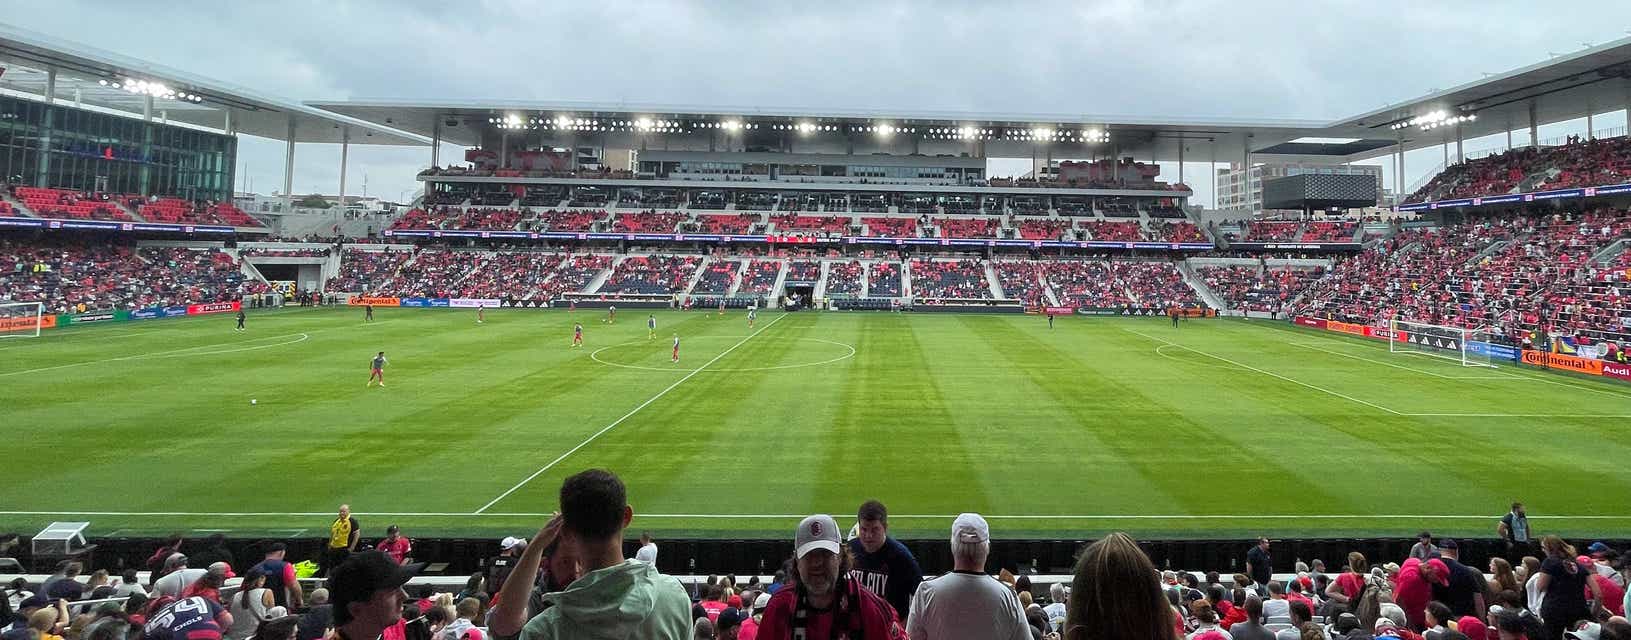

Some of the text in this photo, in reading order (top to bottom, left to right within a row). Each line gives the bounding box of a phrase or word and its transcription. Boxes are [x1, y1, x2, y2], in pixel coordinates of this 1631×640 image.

[204, 303, 232, 311] PURINA
[1603, 365, 1630, 376] Audi
[867, 572, 889, 596] CITY
